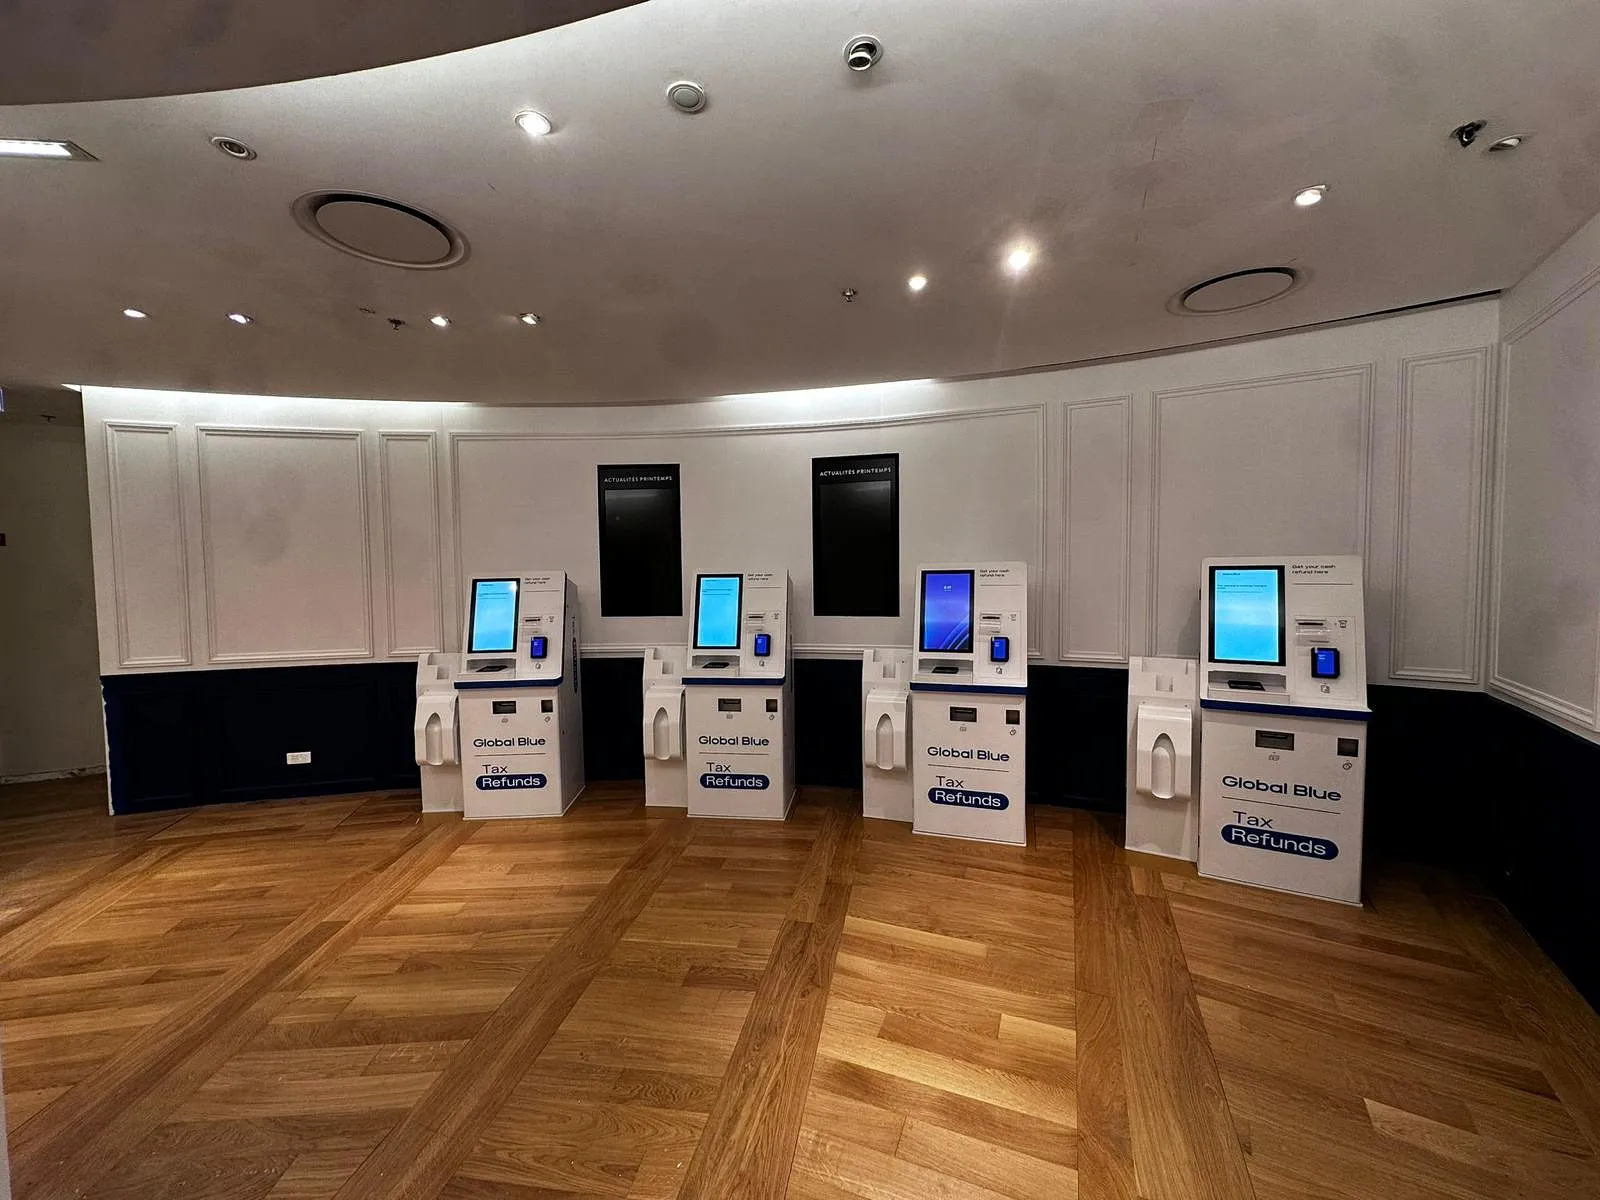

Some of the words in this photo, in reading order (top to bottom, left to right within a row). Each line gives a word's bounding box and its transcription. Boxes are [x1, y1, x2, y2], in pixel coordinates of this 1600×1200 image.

[856, 466, 892, 474] PRINTEMPS
[472, 737, 515, 748] Global
[517, 736, 546, 747] Blue
[698, 735, 739, 746] Global
[741, 736, 770, 747] Blue
[927, 746, 974, 760] Global
[976, 749, 1010, 762] Blue
[481, 763, 508, 775] Tax
[705, 761, 731, 773] Tax
[482, 776, 542, 788] Refunds
[706, 775, 764, 787] Refunds
[935, 775, 964, 789] Tax
[1222, 775, 1288, 795] Global
[1292, 783, 1342, 802] Blue
[935, 790, 1002, 807] Refunds
[1232, 810, 1274, 829] Tax
[1230, 827, 1326, 856] Refunds
